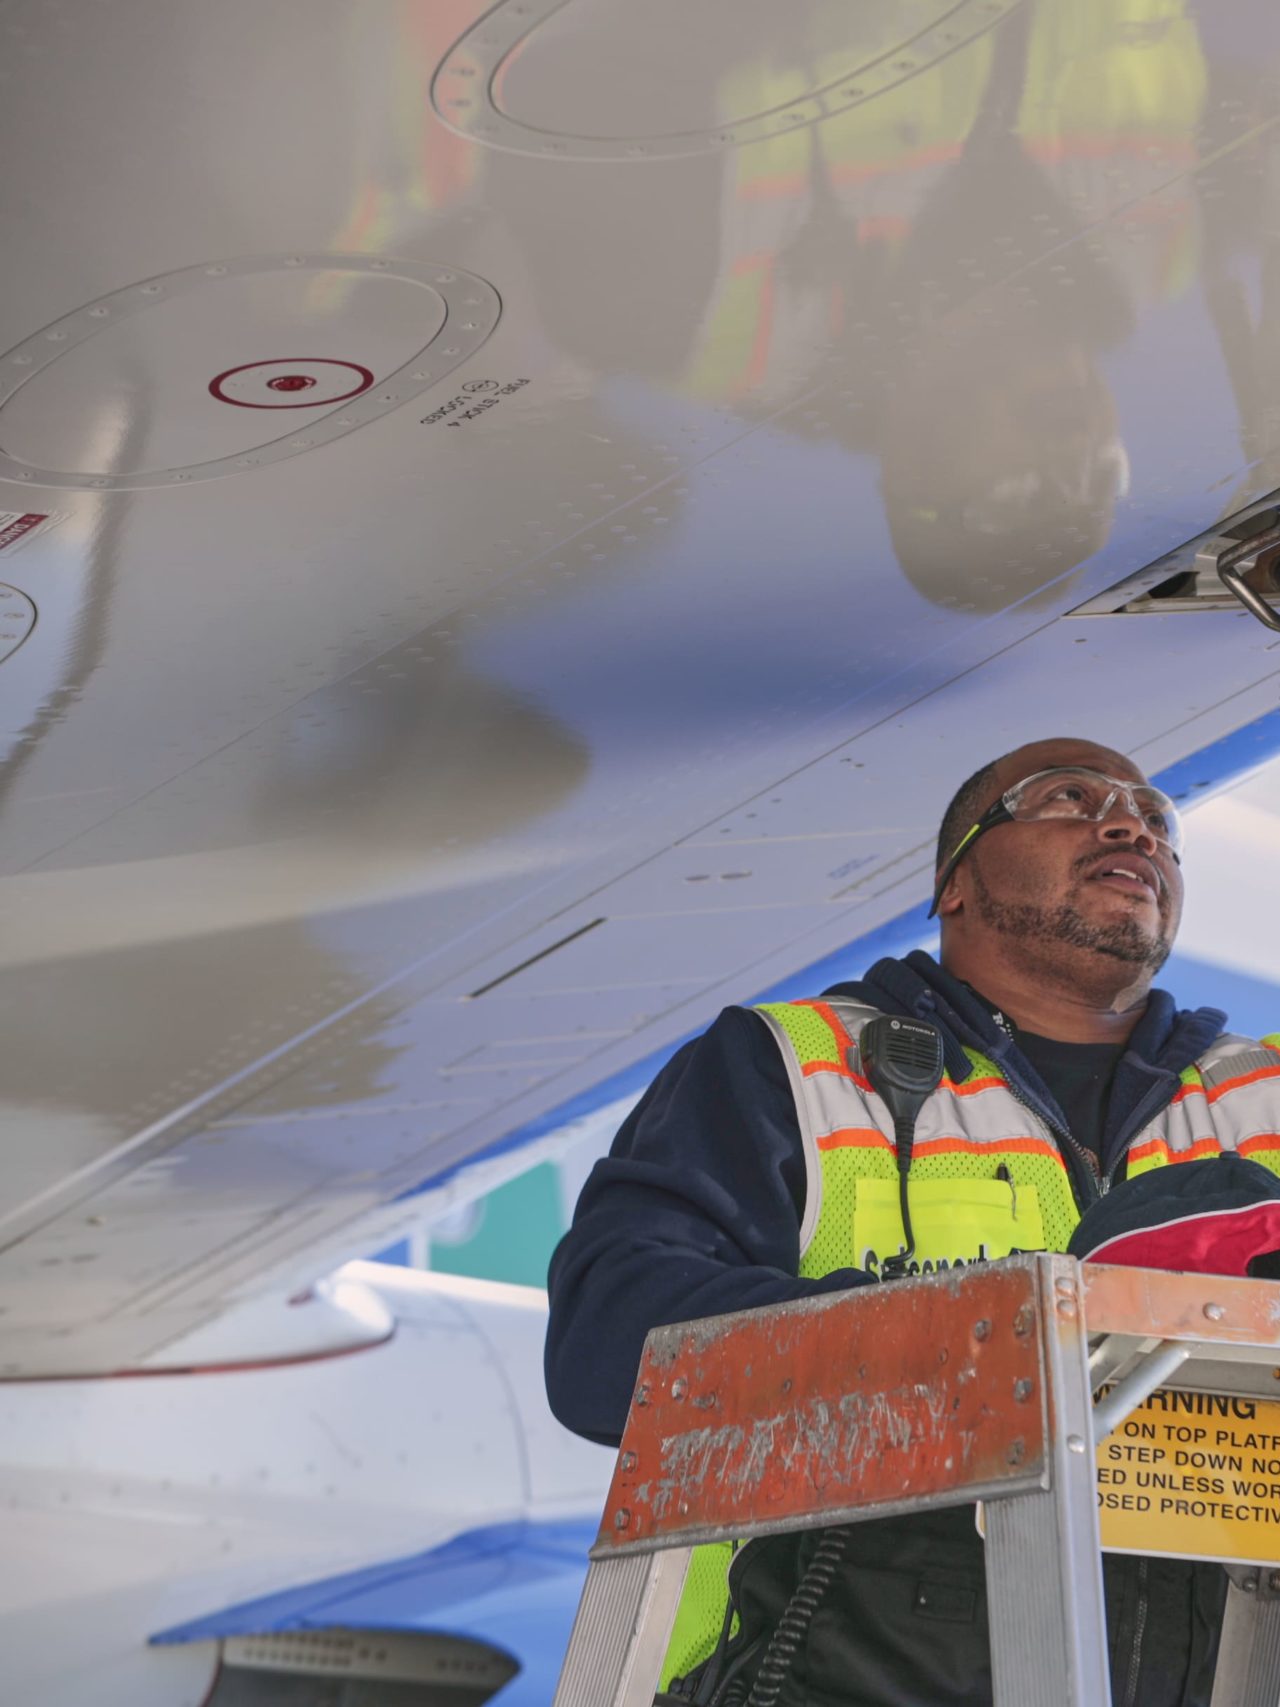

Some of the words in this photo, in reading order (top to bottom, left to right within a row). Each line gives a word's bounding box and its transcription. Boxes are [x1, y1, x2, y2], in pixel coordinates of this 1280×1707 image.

[901, 1024, 936, 1036] MOTOROLA
[1124, 1421, 1156, 1439] ON
[1163, 1425, 1207, 1443] TOP
[1108, 1444, 1166, 1464] STEP
[1175, 1451, 1243, 1472] DOWN
[1136, 1471, 1225, 1494] UNLESS
